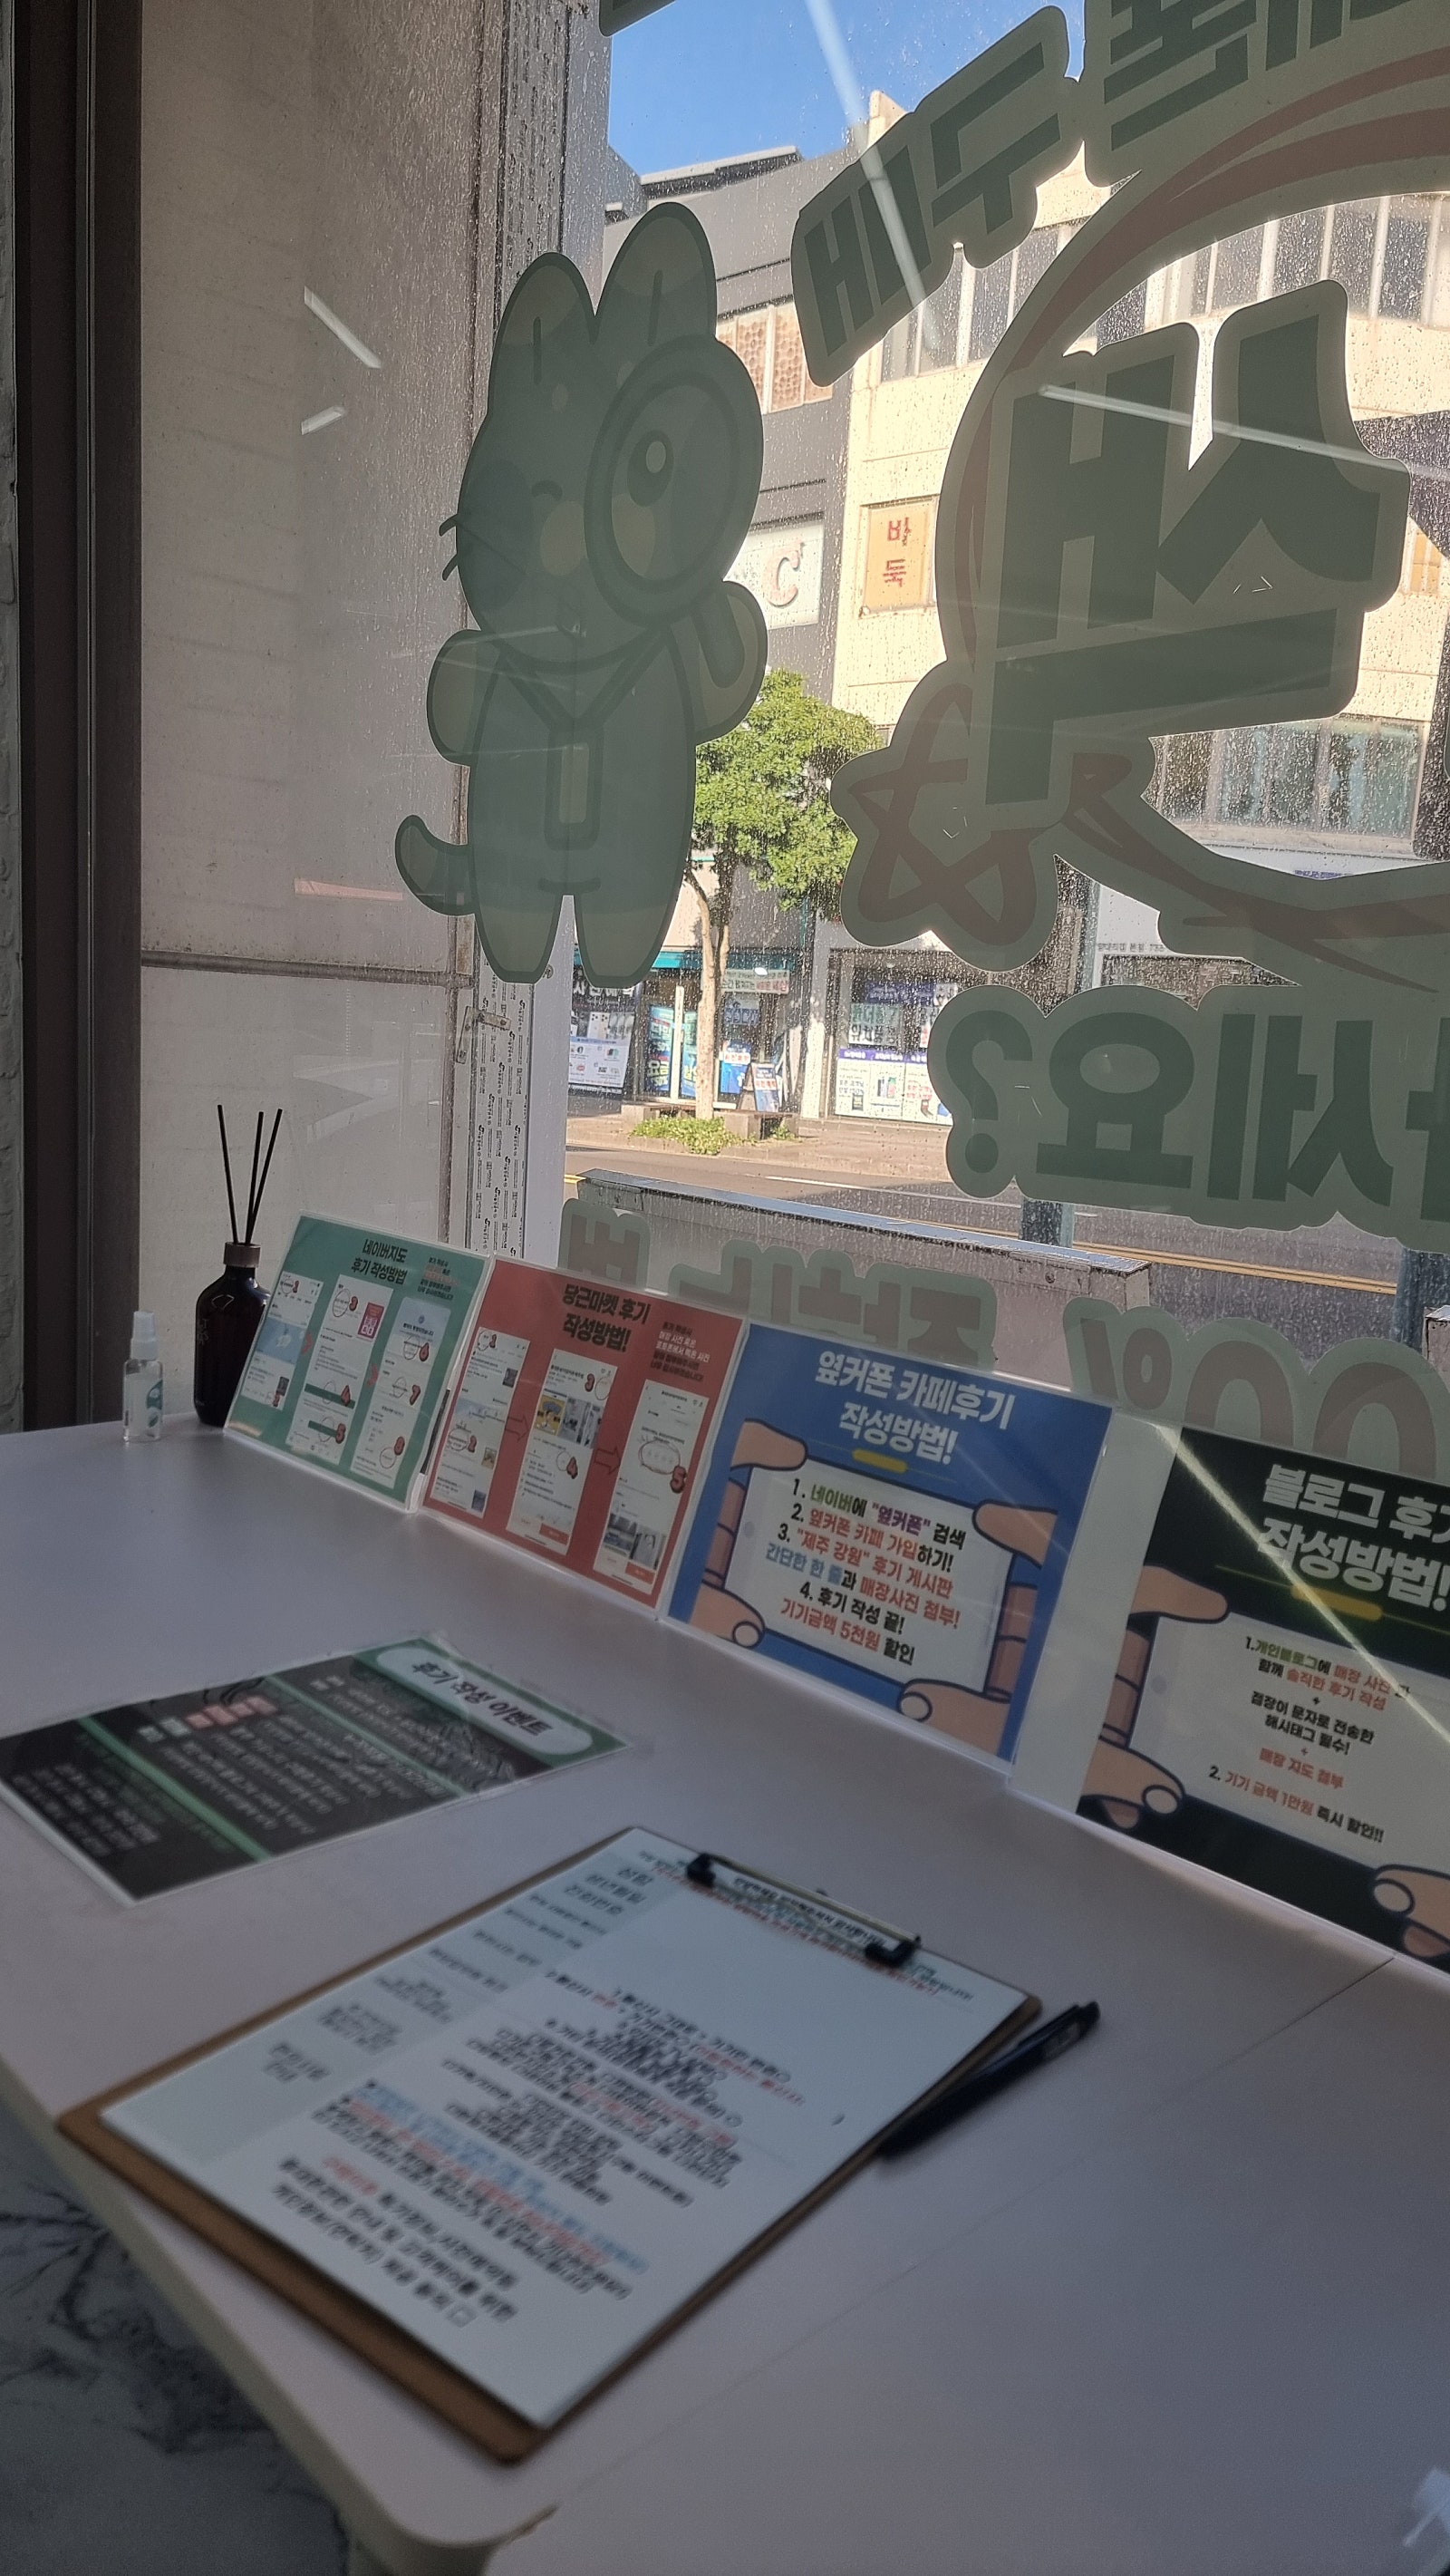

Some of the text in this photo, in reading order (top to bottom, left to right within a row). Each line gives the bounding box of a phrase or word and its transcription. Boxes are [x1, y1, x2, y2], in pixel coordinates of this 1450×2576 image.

[351, 1256, 371, 1274] 후기
[370, 1260, 409, 1284] 작성방법
[362, 1238, 408, 1263] 네이버지도
[562, 1283, 651, 1325] 당근마켓 후기
[562, 1312, 632, 1352] 작성방법!
[815, 1350, 1016, 1430] 옆커폰 카페후기
[838, 1400, 959, 1465] 작성방법!
[810, 1484, 866, 1518] 네이버에
[872, 1501, 931, 1537] "옆커폰"
[934, 1522, 966, 1551] 검색
[1262, 1463, 1385, 1527] 블로그
[778, 1524, 791, 1542] 3.
[872, 1554, 903, 1580] 후기
[905, 1564, 953, 1600] 게시판
[790, 1503, 954, 1573] 2. 옆커폰 카페 가입하기!
[1258, 1516, 1450, 1612] 작성방법!
[765, 1543, 807, 1573] 간단한
[810, 1557, 826, 1579] 한
[859, 1572, 919, 1612] 매장사진
[924, 1600, 960, 1629] 첨부!
[799, 1581, 905, 1634] 4. 후기 작성 끝!
[780, 1598, 915, 1666] 기기금액 5천원 할인
[1257, 1658, 1387, 1711] 함께 솔직한 후기 작성
[1333, 1663, 1362, 1686] 매장
[1264, 1713, 1350, 1756] 해시태그 필수!
[1290, 1702, 1331, 1732] 문자로
[1332, 1715, 1375, 1746] 전송한
[1287, 1755, 1315, 1779] 지도
[1208, 1765, 1385, 1845] 2. 기기 금액 1만원 즉시 할인!!
